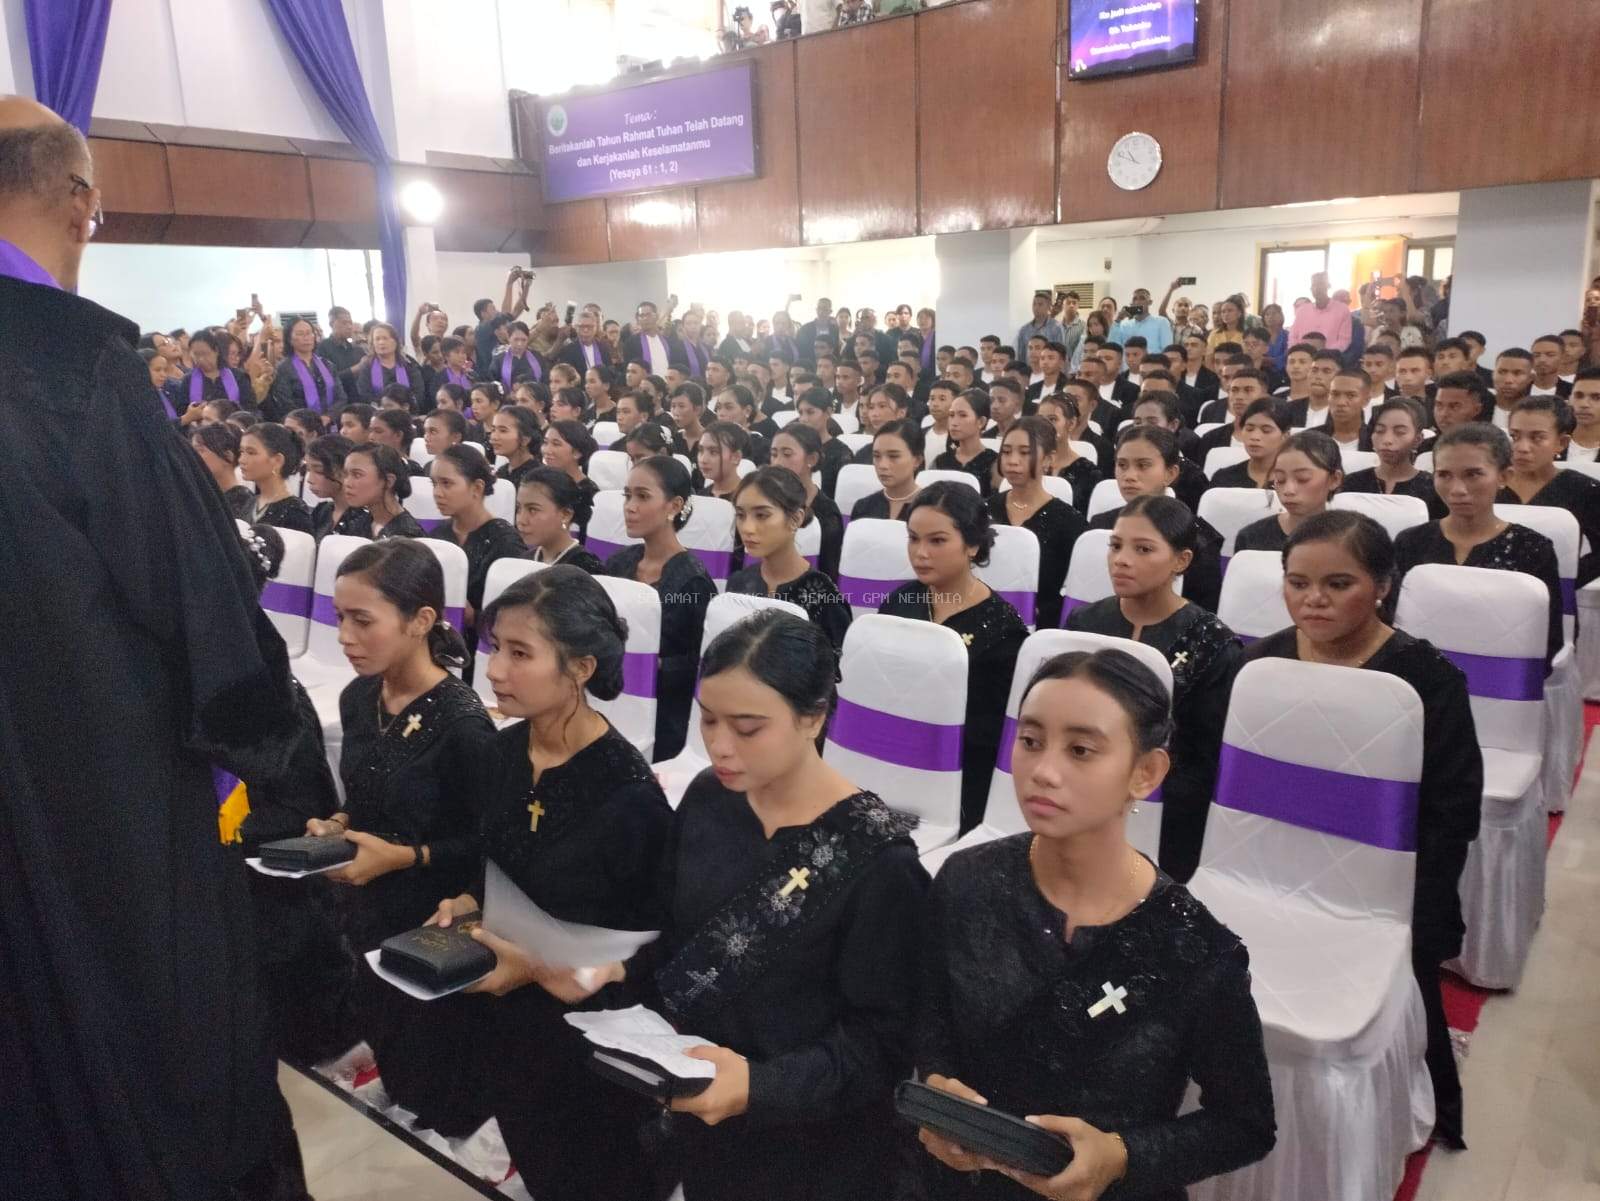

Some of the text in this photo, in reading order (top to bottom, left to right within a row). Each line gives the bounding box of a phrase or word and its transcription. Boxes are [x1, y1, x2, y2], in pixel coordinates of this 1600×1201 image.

[548, 114, 744, 155] Beritakanlah Tahun Rahmat Tuhan Telah Datang
[576, 139, 712, 168] dan Kerjakanlah Keselamatanmu
[609, 165, 641, 182] (Yesaya
